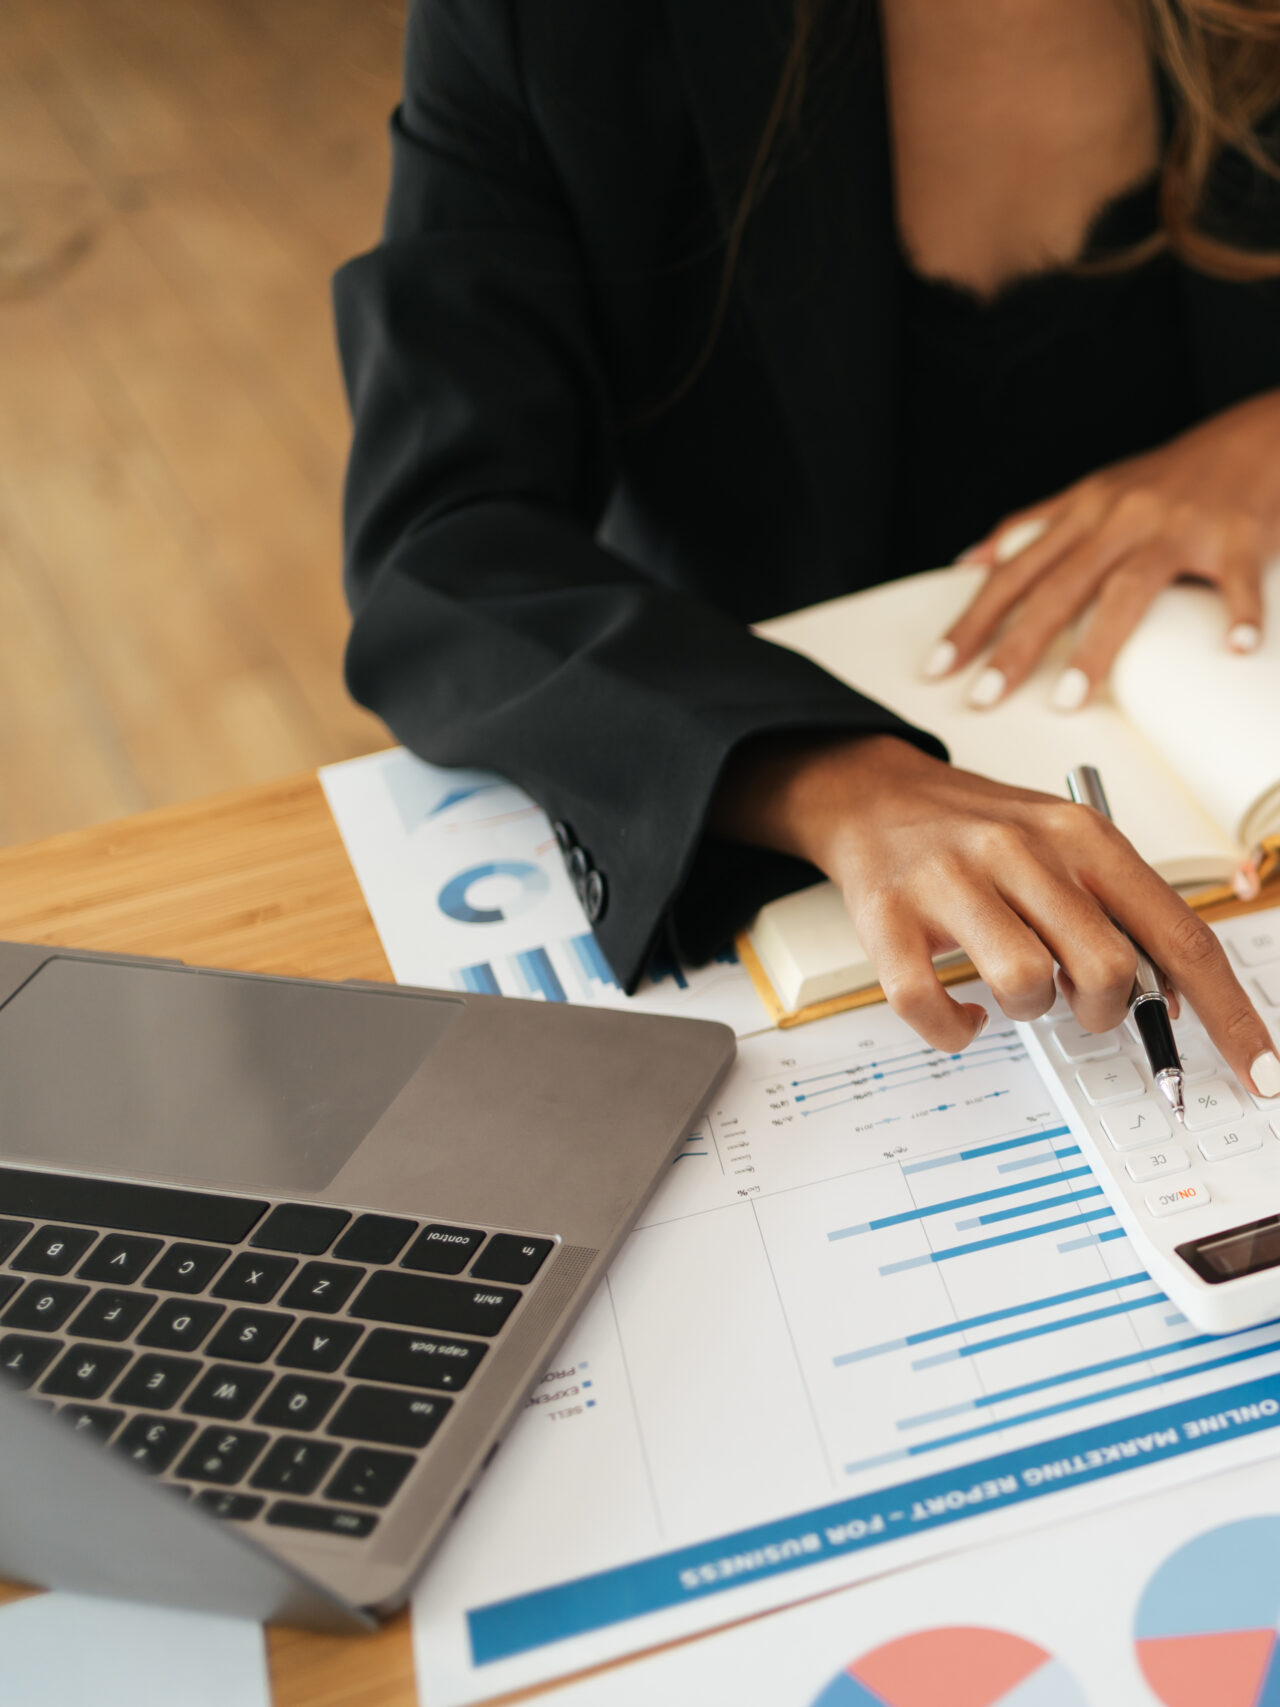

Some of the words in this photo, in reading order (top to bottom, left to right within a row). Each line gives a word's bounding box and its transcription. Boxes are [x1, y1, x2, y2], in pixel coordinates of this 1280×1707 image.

[1198, 1095, 1217, 1108] %
[1223, 1133, 1239, 1145] GT
[1150, 1154, 1167, 1166] CE
[1159, 1187, 1196, 1205] ON/AC
[427, 1232, 469, 1245] control
[47, 1243, 63, 1255] B
[522, 1246, 535, 1256] fn
[110, 1252, 126, 1264] V
[179, 1261, 194, 1274] C
[246, 1270, 263, 1284] X
[312, 1280, 329, 1293] Z
[36, 1296, 53, 1310] G
[474, 1293, 502, 1305] shift
[104, 1306, 120, 1320] F
[173, 1316, 190, 1330] D
[240, 1327, 257, 1341] S
[313, 1336, 328, 1350] A
[411, 1341, 436, 1354] lock
[438, 1345, 468, 1358] caps
[6, 1353, 23, 1367] T
[77, 1362, 95, 1377] R
[540, 1367, 575, 1384] PRO
[147, 1373, 164, 1387] E
[214, 1383, 236, 1398] W
[289, 1394, 307, 1410] Q
[411, 1401, 433, 1414] tab
[548, 1406, 583, 1421] SELL
[1182, 1398, 1279, 1439] ONLINE
[75, 1415, 93, 1430] 4
[147, 1426, 165, 1441] 3
[218, 1435, 237, 1451] 2
[295, 1448, 307, 1462] 1
[1022, 1427, 1179, 1483] MARKETING
[910, 1474, 1016, 1521] REPORT
[826, 1514, 885, 1545] FOR
[679, 1532, 821, 1591] BUSINESS
